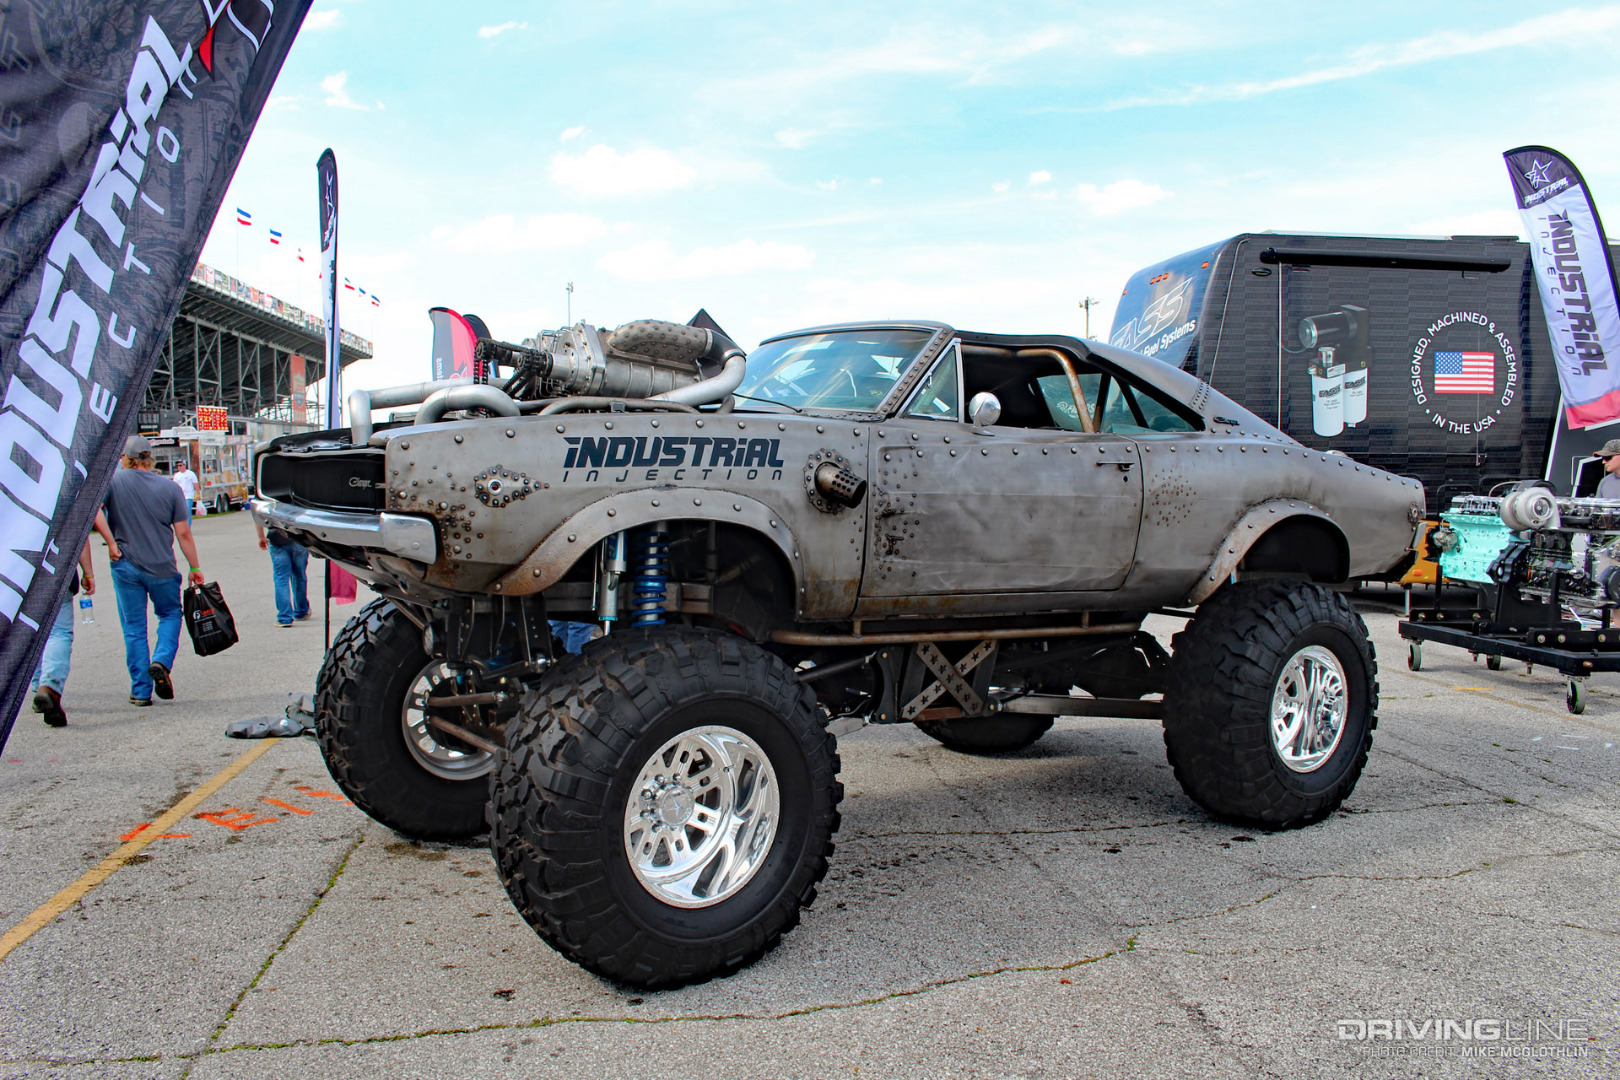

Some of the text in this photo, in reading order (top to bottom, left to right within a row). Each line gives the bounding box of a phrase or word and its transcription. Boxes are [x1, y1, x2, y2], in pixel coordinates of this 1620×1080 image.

[1160, 319, 1196, 349] Systems
[1411, 311, 1517, 406] DESIGNED, MACHINED & ASSEMBLED
[1432, 413, 1496, 434] IN THE USA
